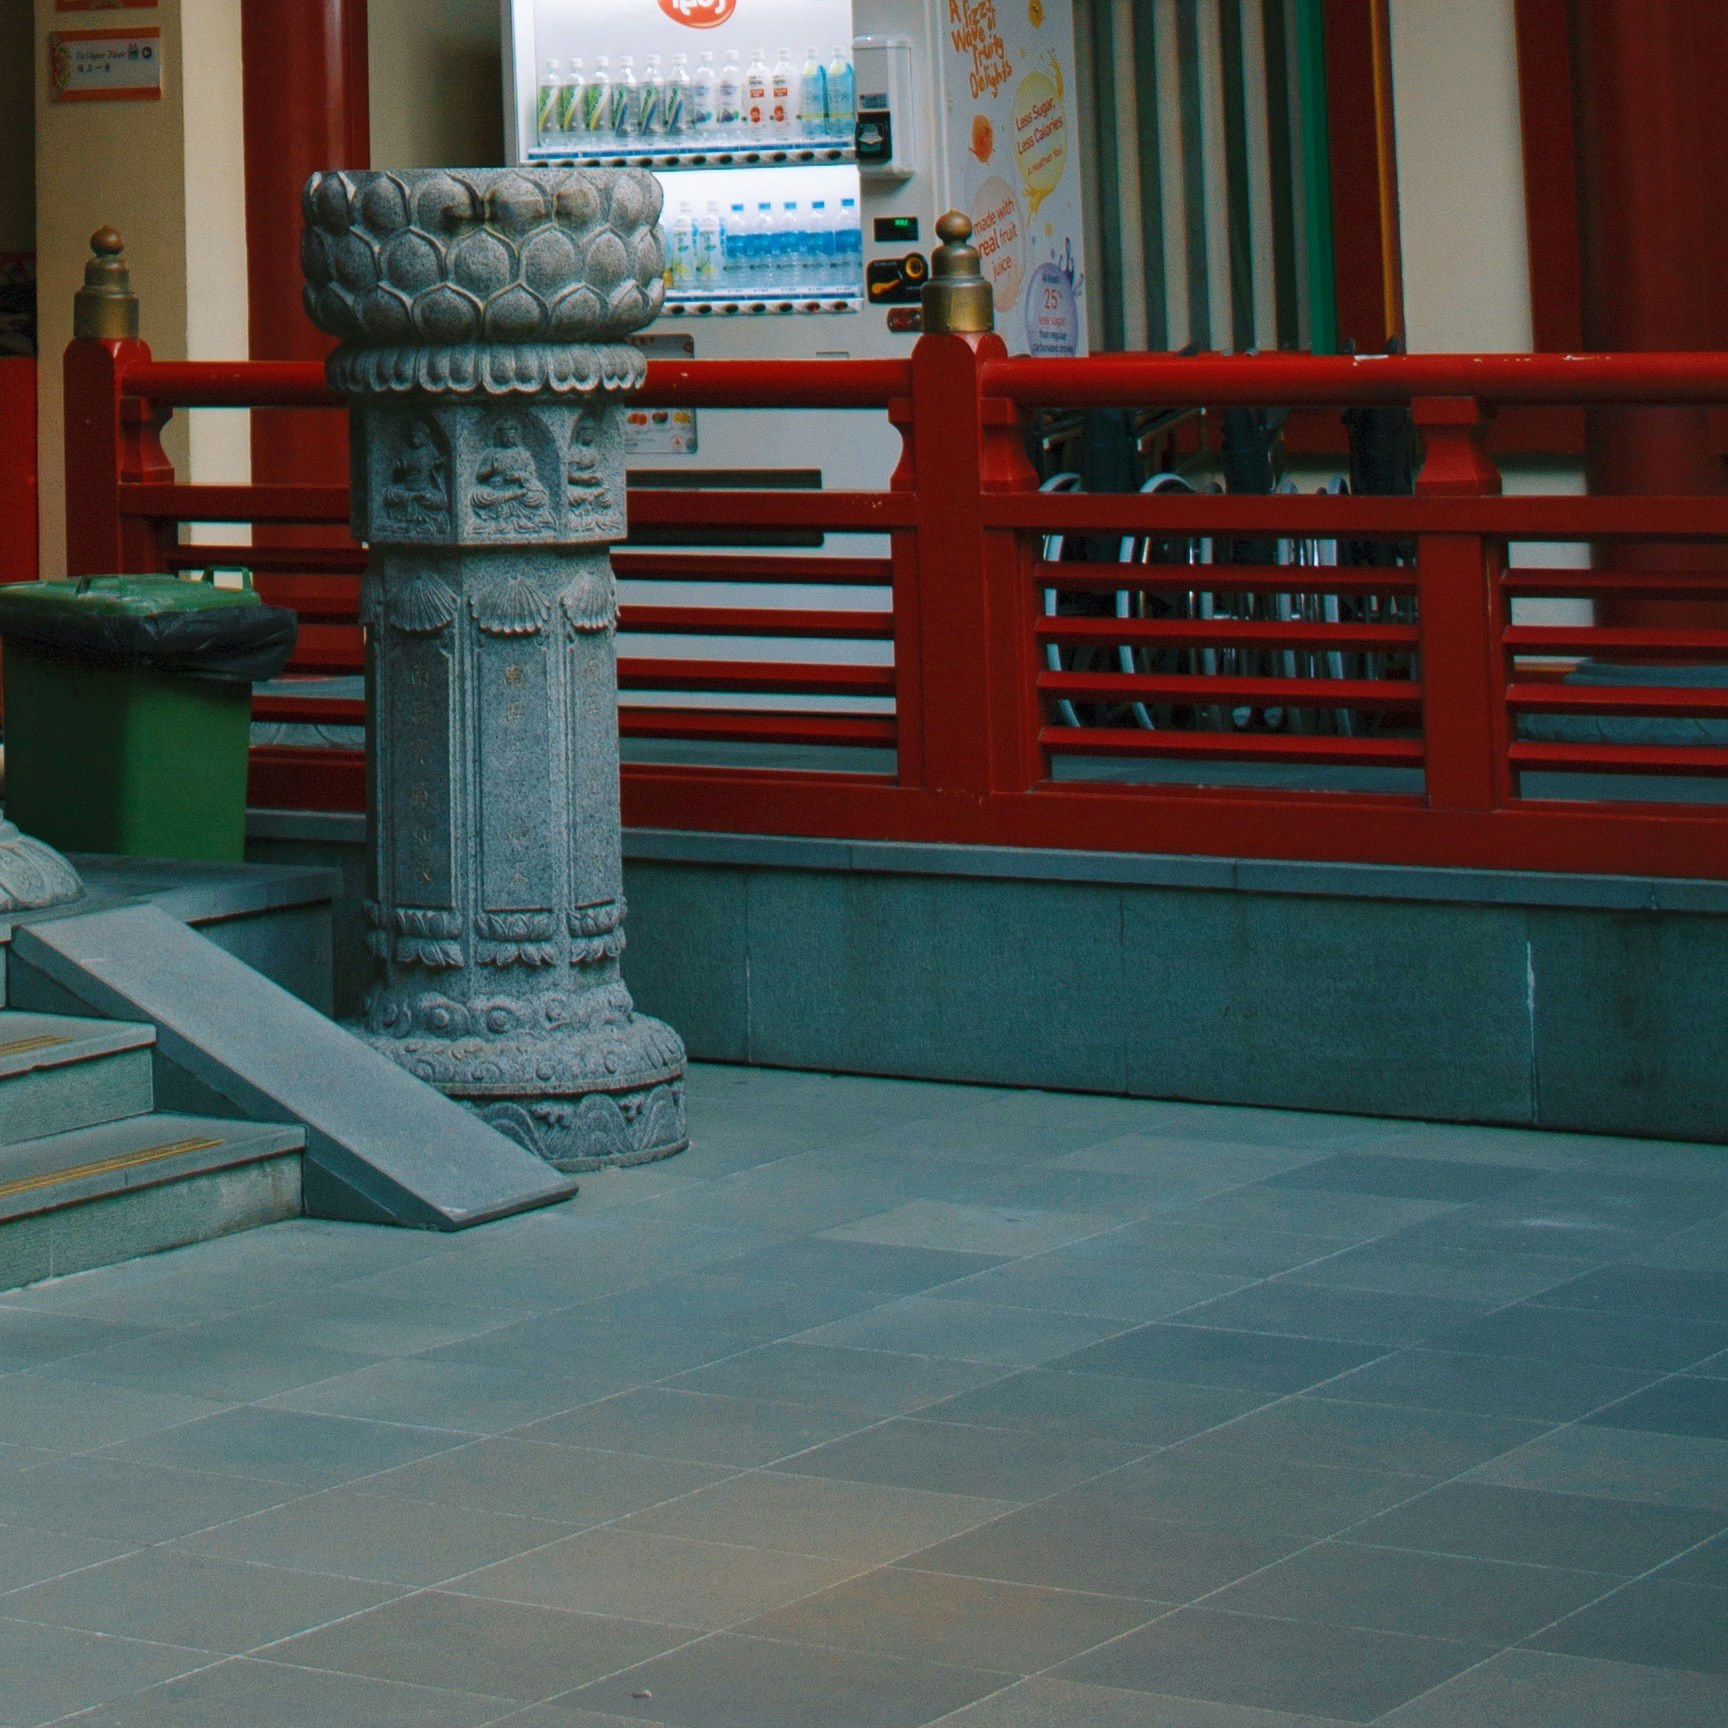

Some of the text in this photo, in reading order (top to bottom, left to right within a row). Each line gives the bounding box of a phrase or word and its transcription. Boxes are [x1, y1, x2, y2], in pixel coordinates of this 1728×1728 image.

[1015, 111, 1033, 131] Less
[1017, 136, 1035, 155] Less
[997, 198, 1014, 221] with
[978, 222, 1018, 257] real fruit
[992, 255, 1013, 282] juice
